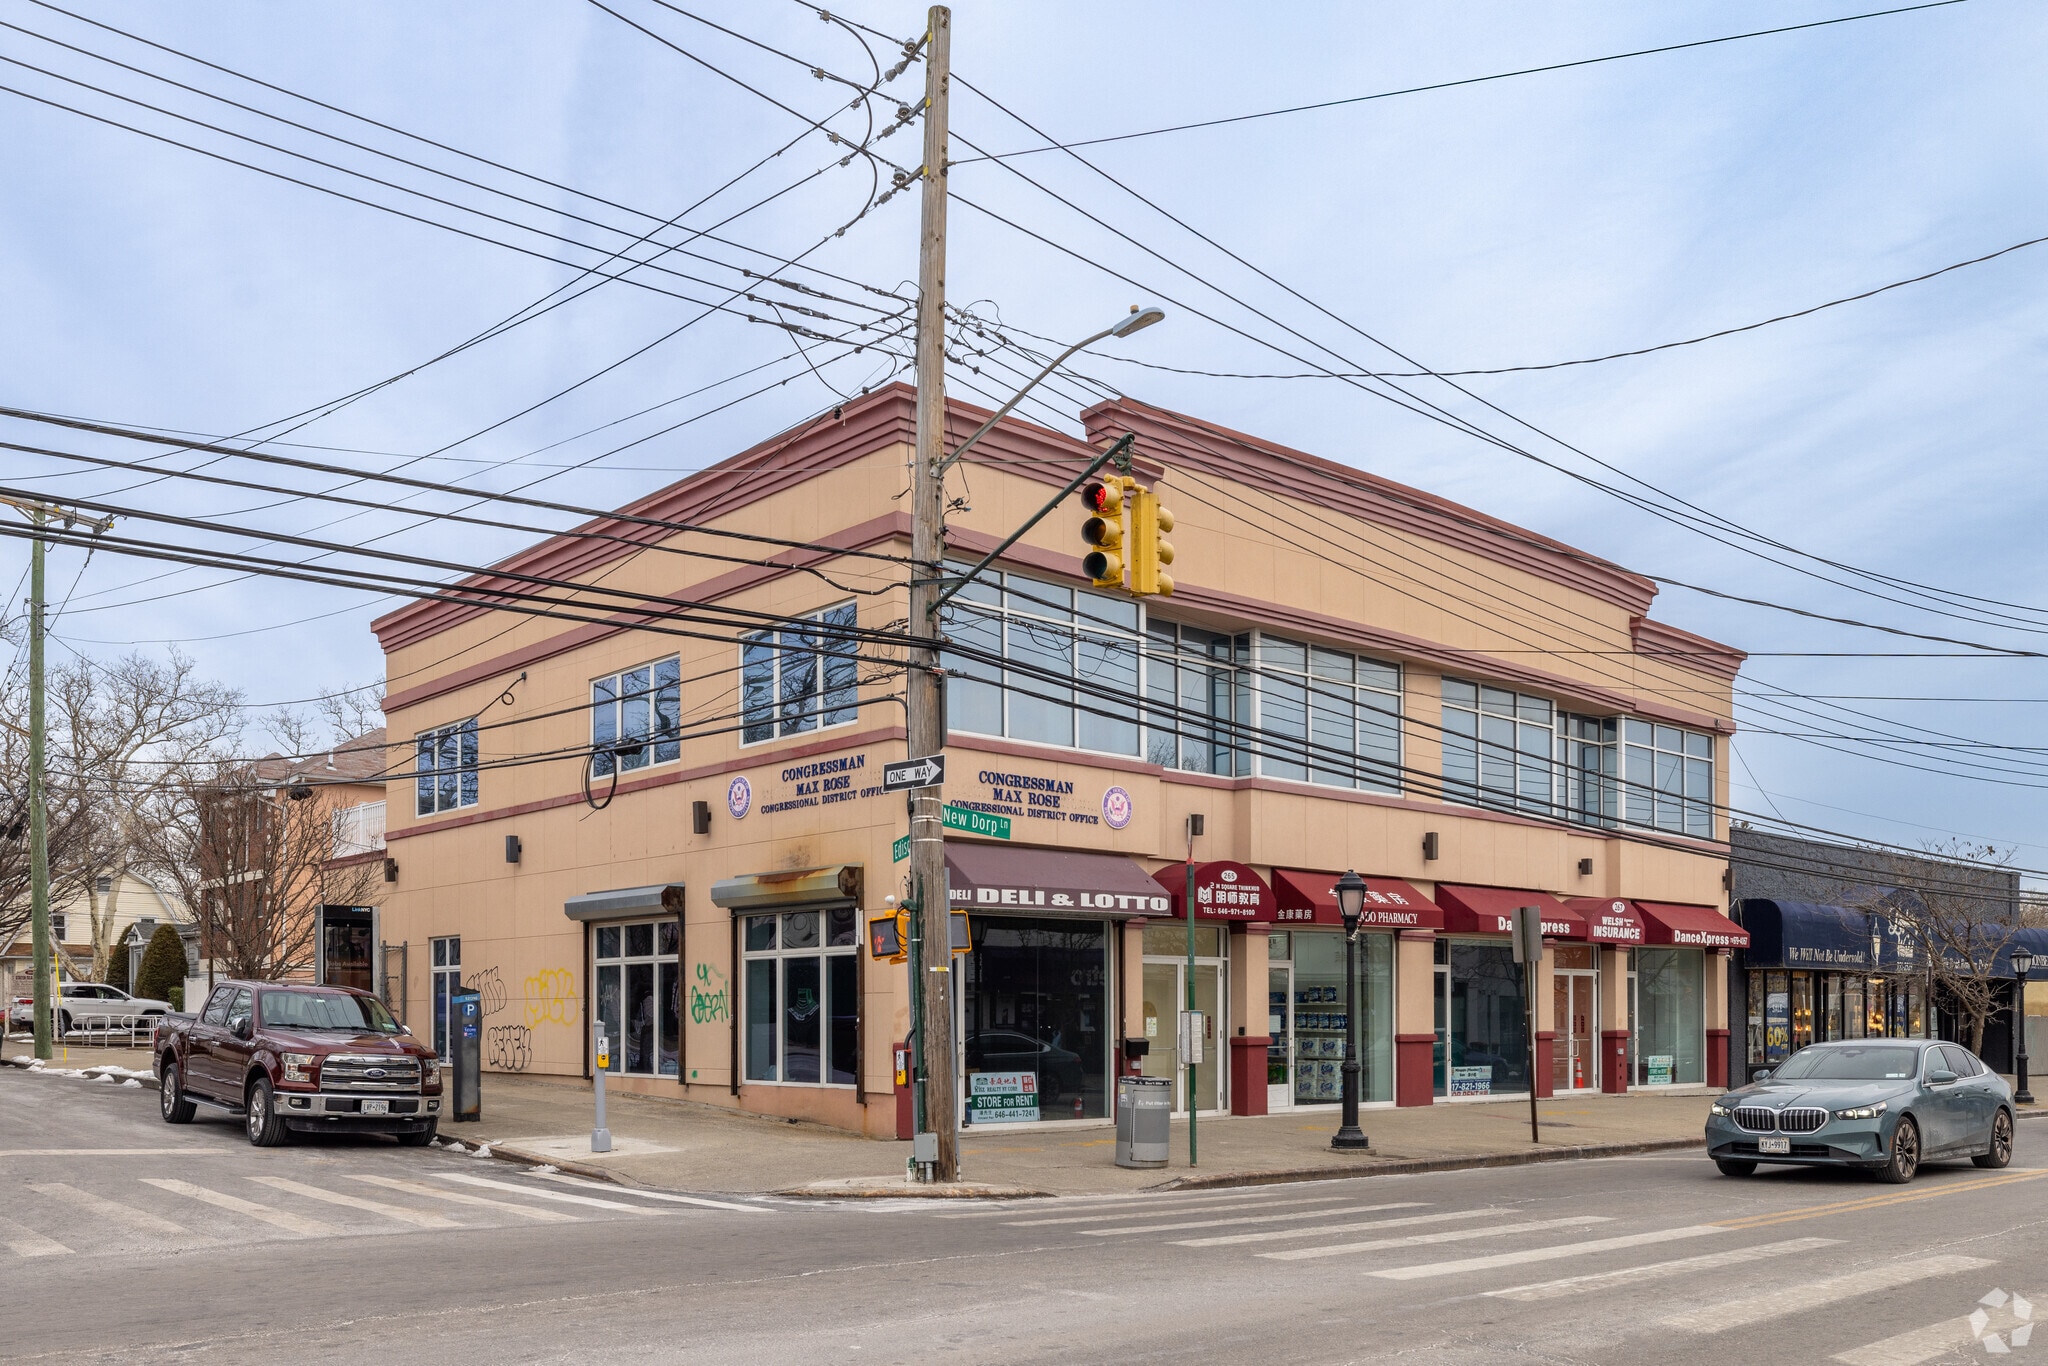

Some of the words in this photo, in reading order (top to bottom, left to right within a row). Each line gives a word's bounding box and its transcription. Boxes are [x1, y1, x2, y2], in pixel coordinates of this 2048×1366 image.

[782, 754, 865, 782] CONGRESSMAN
[889, 769, 907, 782] ONE
[914, 765, 933, 779] WAY
[796, 782, 819, 796] MAX
[823, 775, 851, 792] ROSE
[979, 771, 1074, 794] CONGRESSMAN
[761, 799, 819, 814] CONGRESSIONAL
[822, 791, 857, 806] DISTRICT
[861, 788, 889, 799] OFFIC
[993, 788, 1022, 804] MAX
[1028, 793, 1061, 808] ROSE
[943, 808, 967, 826] New
[972, 814, 998, 836] Dorp
[1000, 819, 1009, 829] Ln
[1027, 808, 1067, 821] DISTRICT
[1069, 813, 1099, 825] OFFICE
[1224, 872, 1235, 880] 265
[949, 889, 971, 901] DELI
[977, 888, 1045, 906] DELI
[1051, 893, 1075, 907] &
[1080, 893, 1169, 911] LOTTO
[1217, 908, 1256, 916] 646-971-8100
[1378, 912, 1418, 924] PHARMACY
[1498, 916, 1570, 935] Dapress
[1602, 916, 1624, 926] WELSH
[1593, 925, 1641, 939] INSURANCE
[1674, 929, 1729, 946] DanceXpress
[1789, 947, 1799, 960] We
[1800, 947, 1813, 961] Will
[1813, 948, 1825, 961] Not
[1825, 949, 1833, 962] Be
[467, 1004, 475, 1016] P
[1767, 1026, 1788, 1047] 60%
[1451, 1082, 1490, 1091] 17-821-1966
[977, 1096, 1001, 1107] STORE
[1003, 1099, 1015, 1107] FOR
[1015, 1095, 1033, 1106] RENT
[994, 1110, 1035, 1119] 646-441-7241
